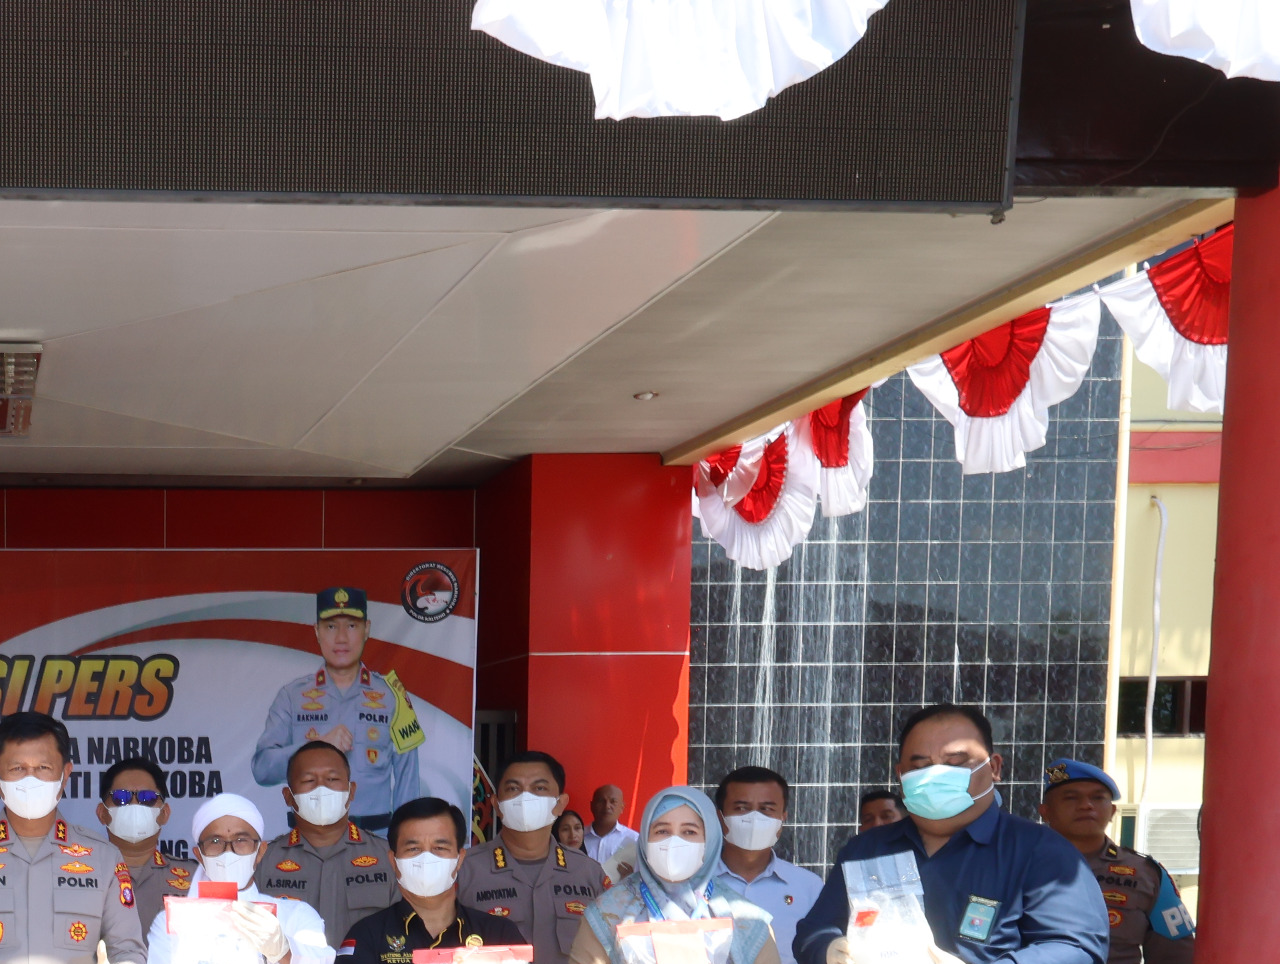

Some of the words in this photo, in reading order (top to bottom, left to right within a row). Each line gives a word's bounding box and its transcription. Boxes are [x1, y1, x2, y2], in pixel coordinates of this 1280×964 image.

[33, 657, 176, 719] PERS
[359, 712, 389, 724] POLRI
[57, 876, 98, 888] POLRI
[266, 878, 307, 889] A.SIRAIT
[345, 872, 388, 886] POLRI
[1097, 874, 1138, 888] POLRI
[553, 884, 592, 897] POLRI
